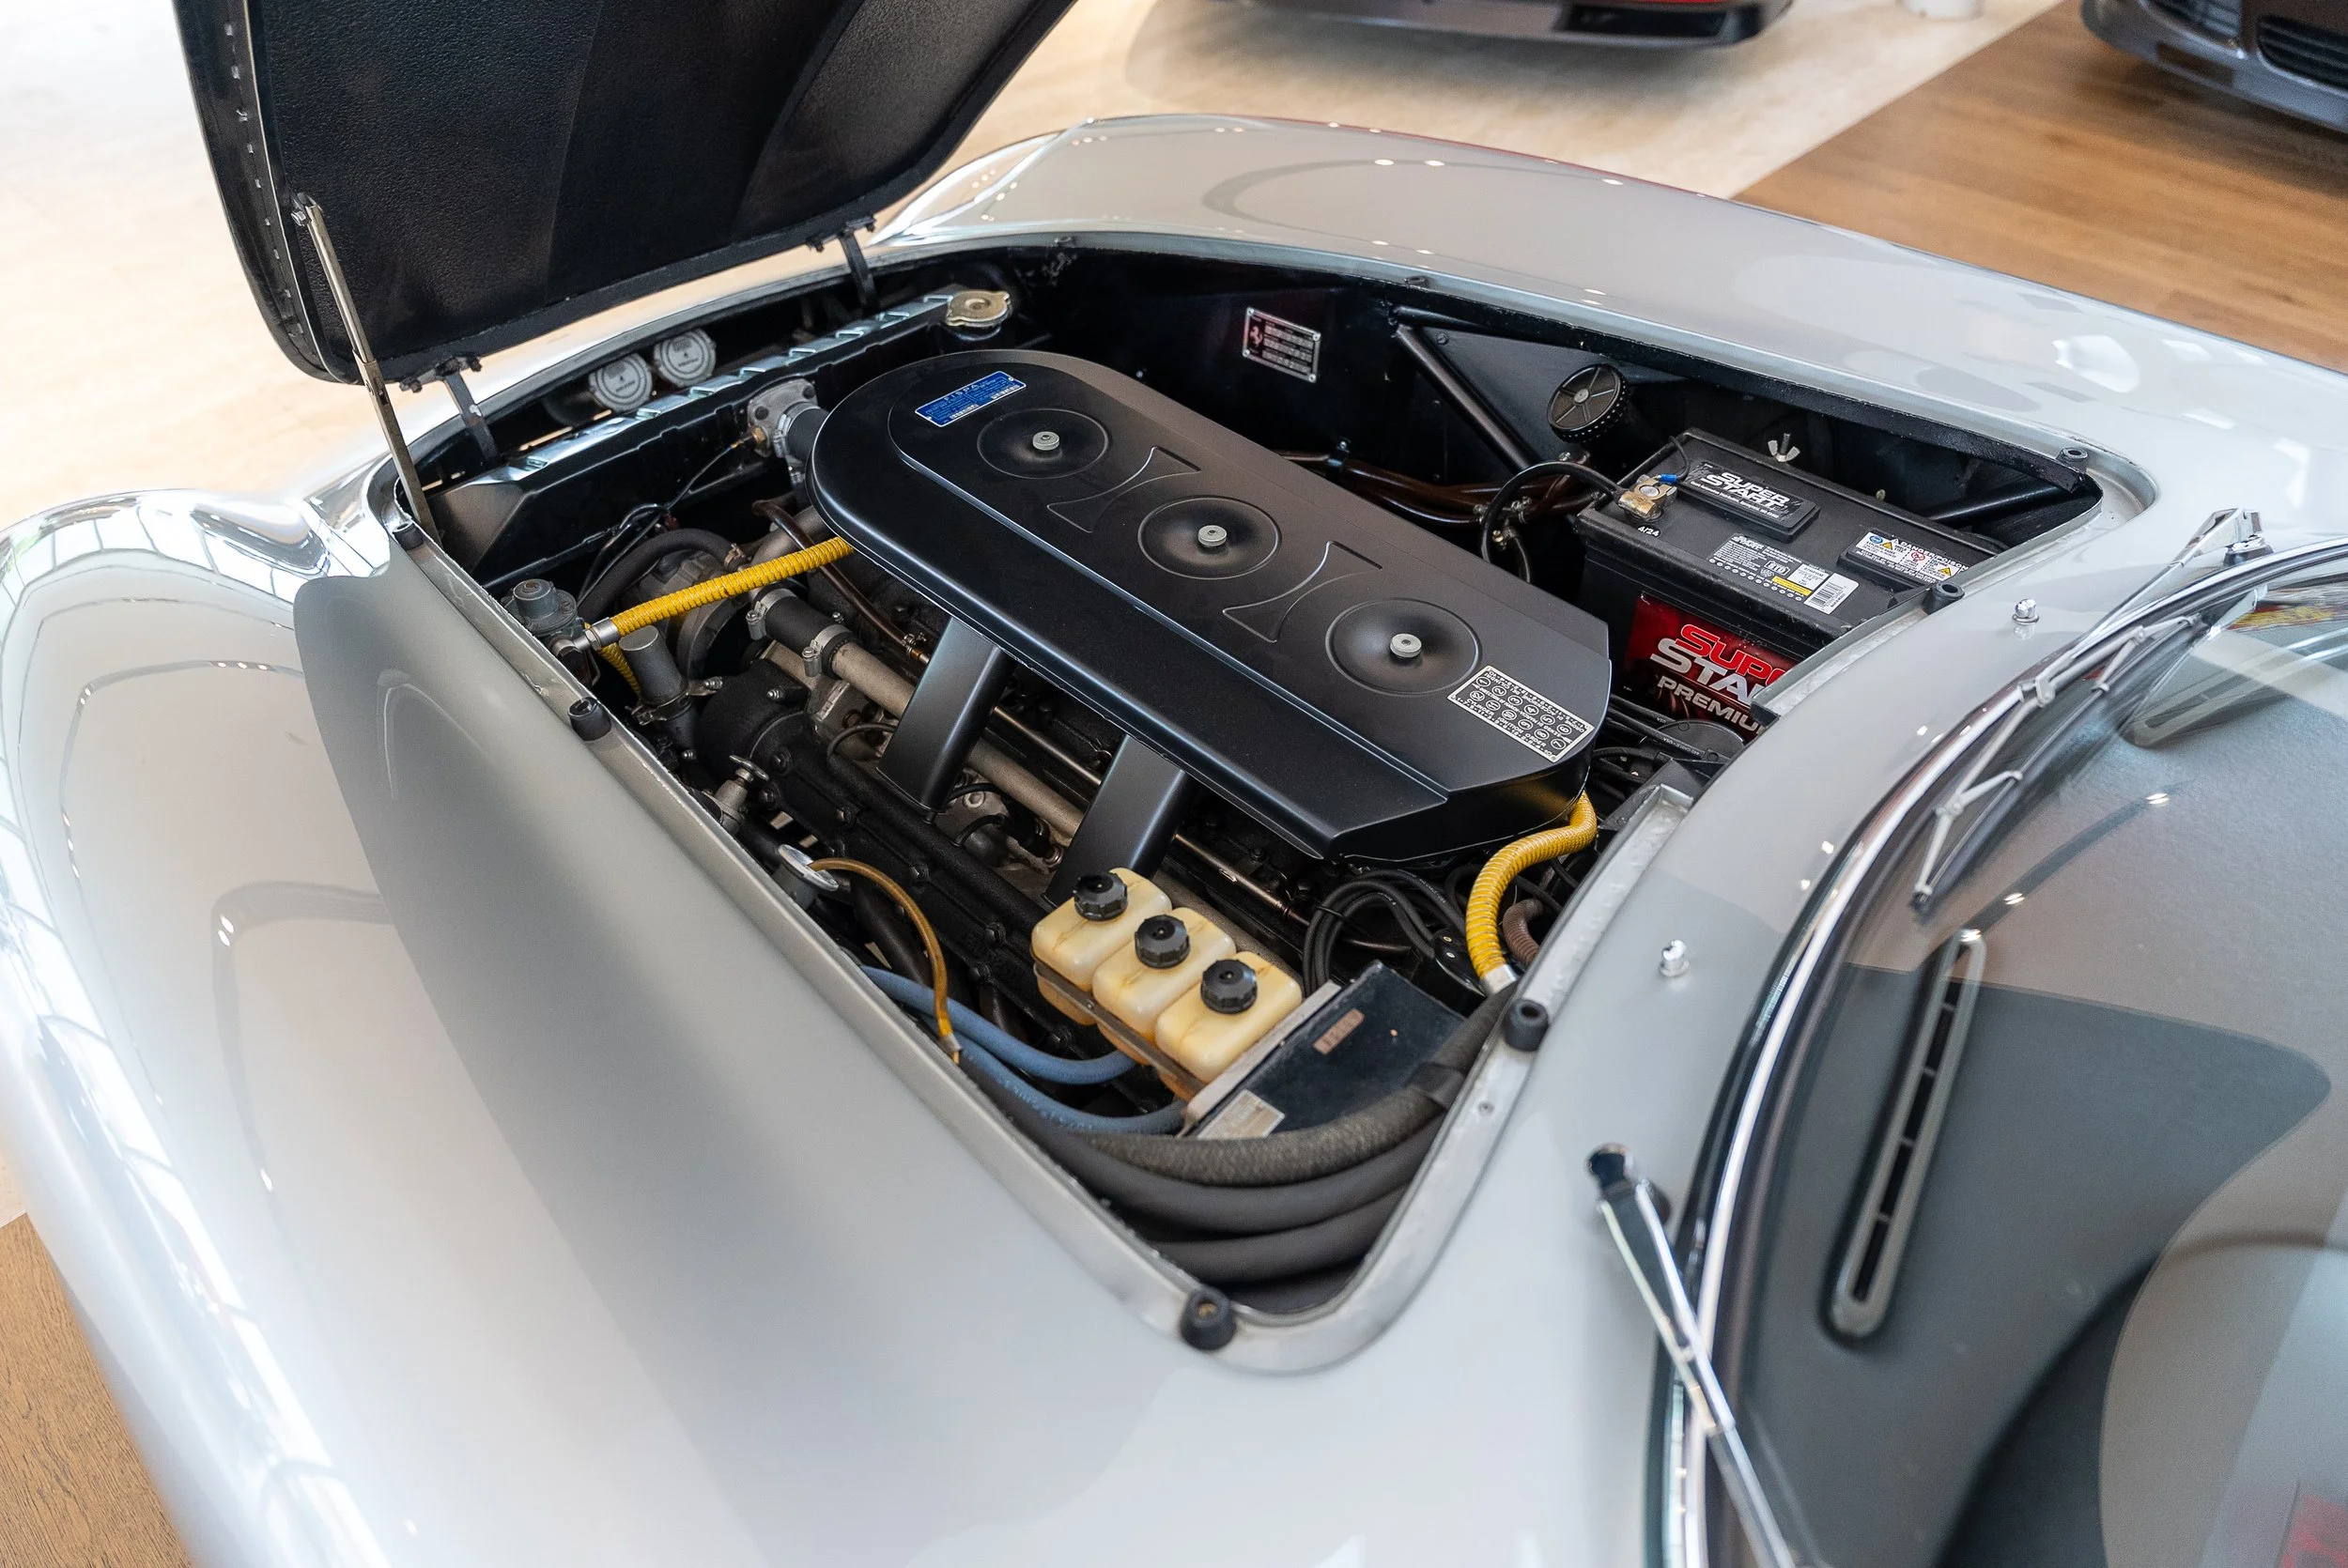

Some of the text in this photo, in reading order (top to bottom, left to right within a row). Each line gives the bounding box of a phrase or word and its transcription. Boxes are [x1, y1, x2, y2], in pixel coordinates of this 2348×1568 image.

[1700, 474, 1785, 511] START
[1721, 471, 1790, 504] SUPER
[1637, 525, 1661, 537] 4/24
[1465, 697, 1548, 747] CYLINDER IGNITION ORDER
